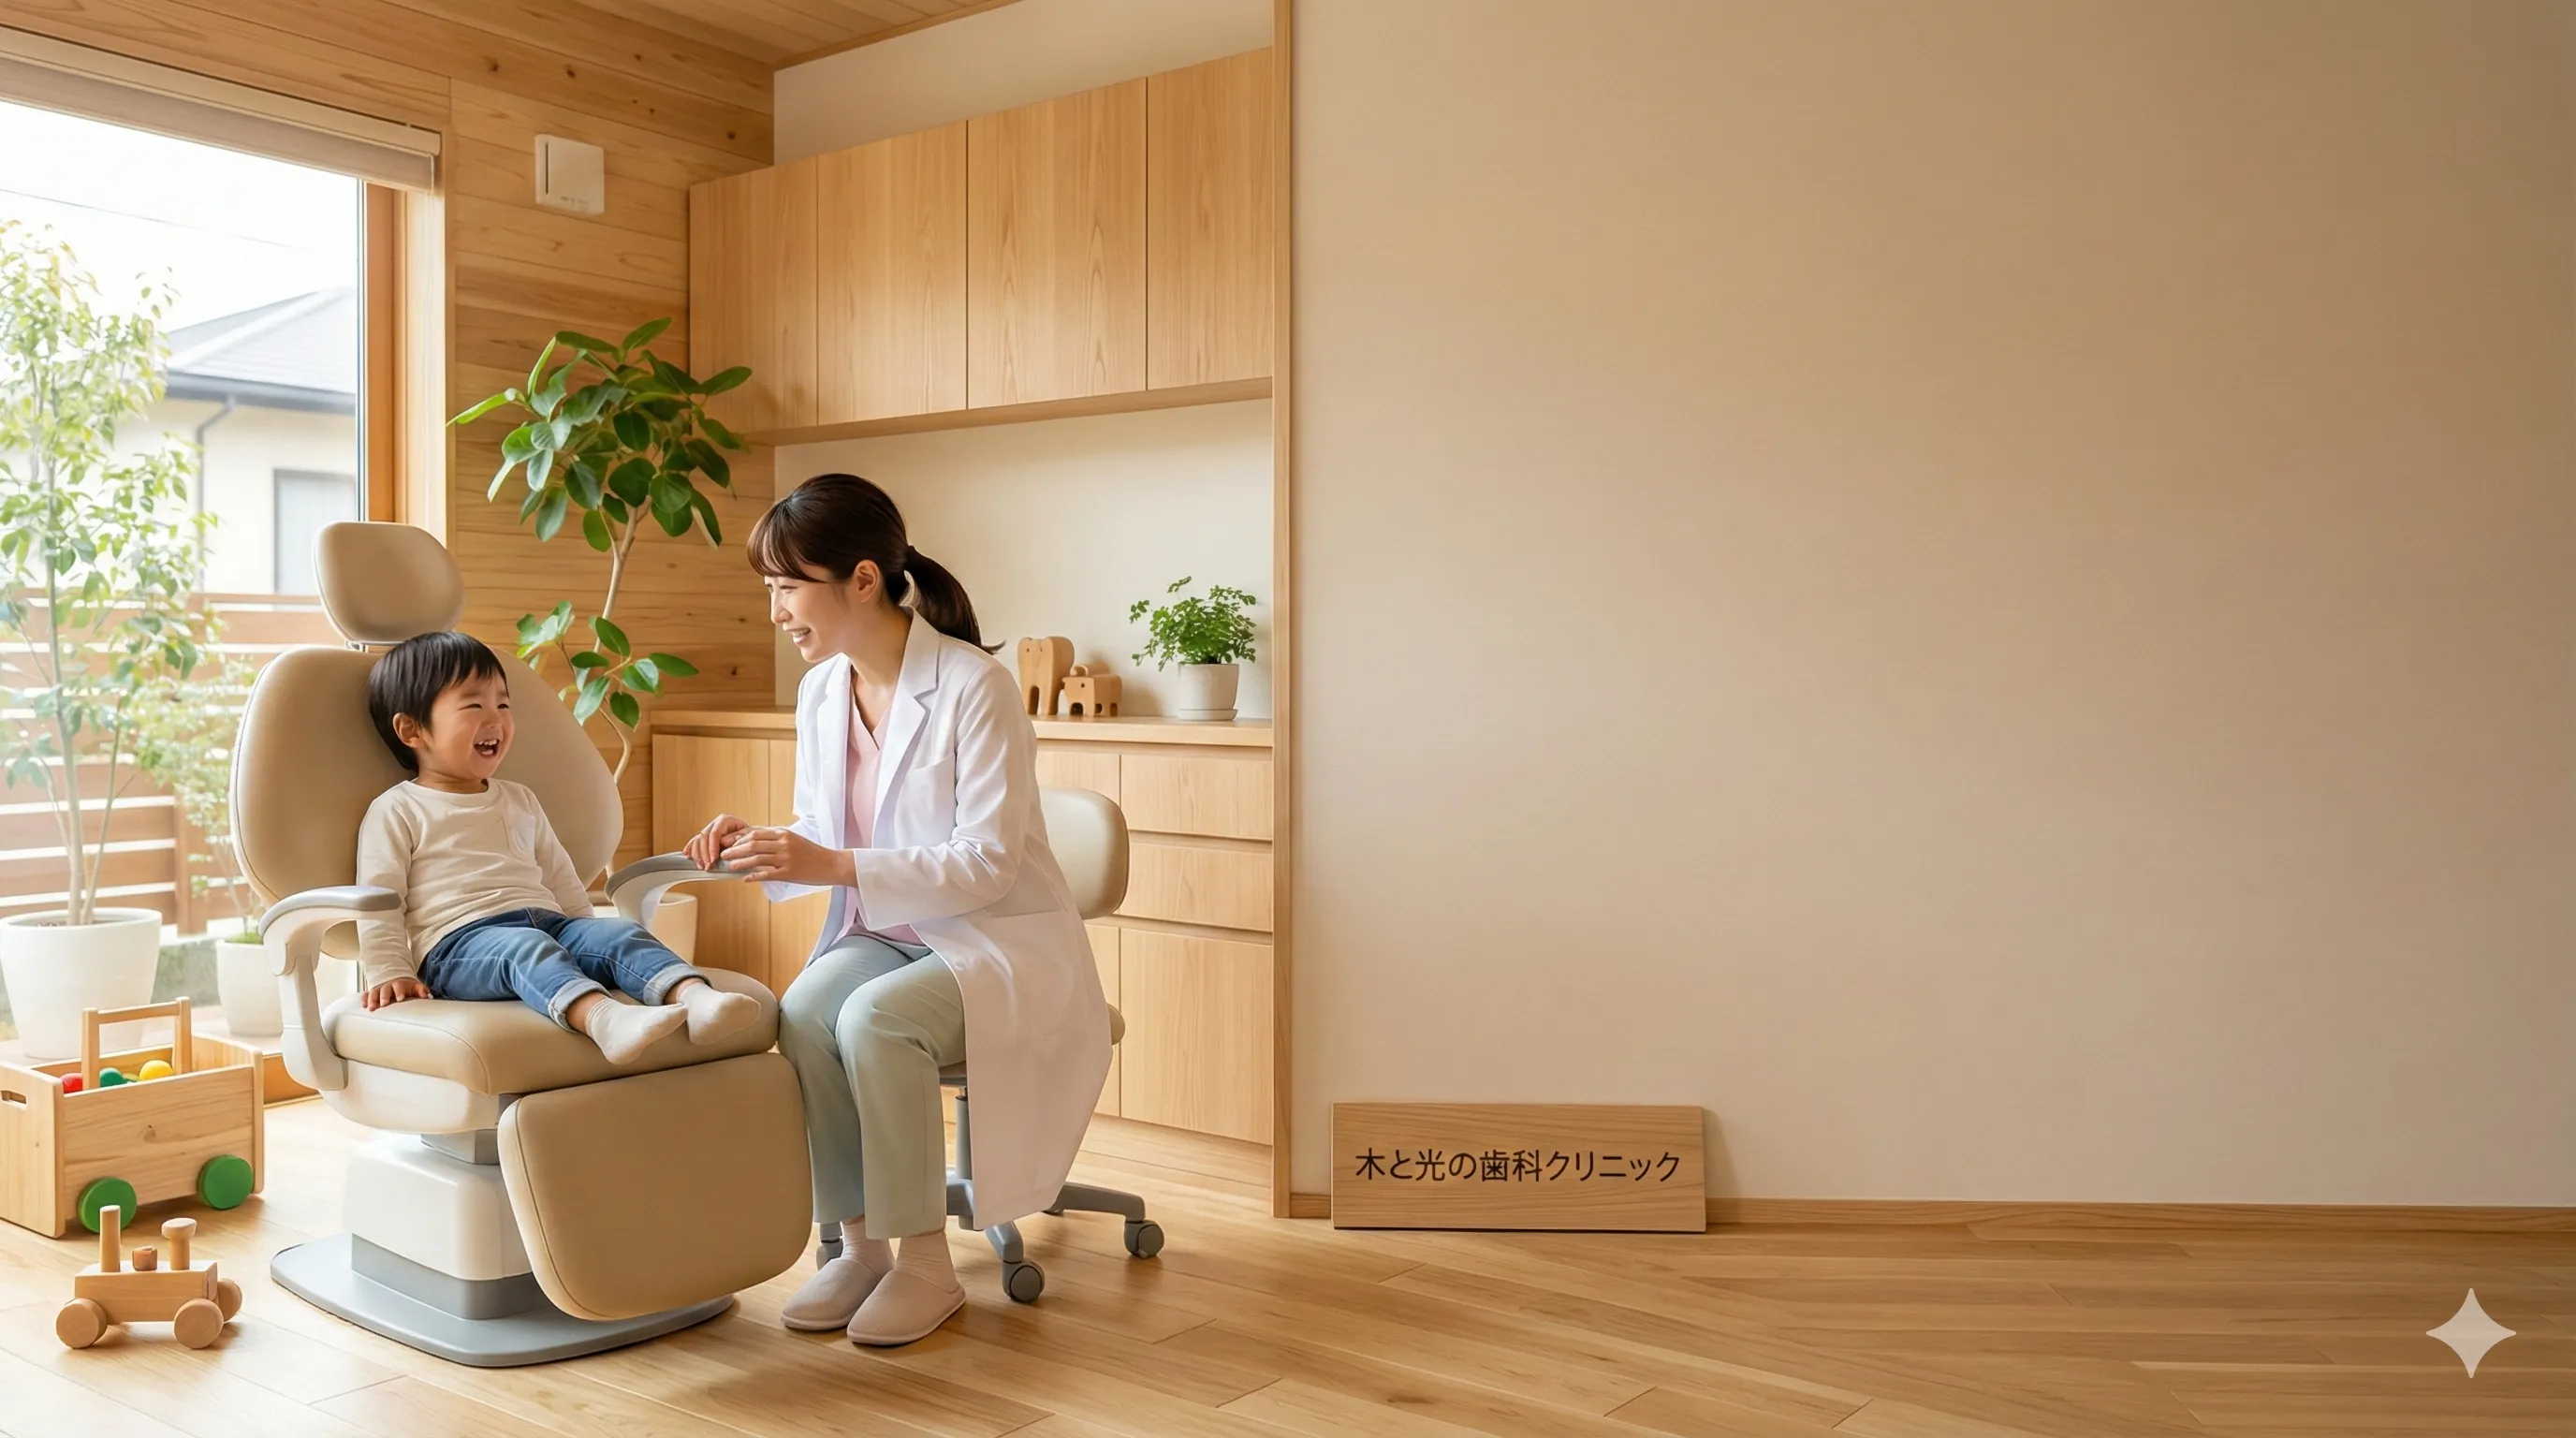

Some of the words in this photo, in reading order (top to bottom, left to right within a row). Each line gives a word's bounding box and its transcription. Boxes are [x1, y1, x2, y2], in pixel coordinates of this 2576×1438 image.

[1354, 1147, 1680, 1182] 木と光の歯科クリニック
